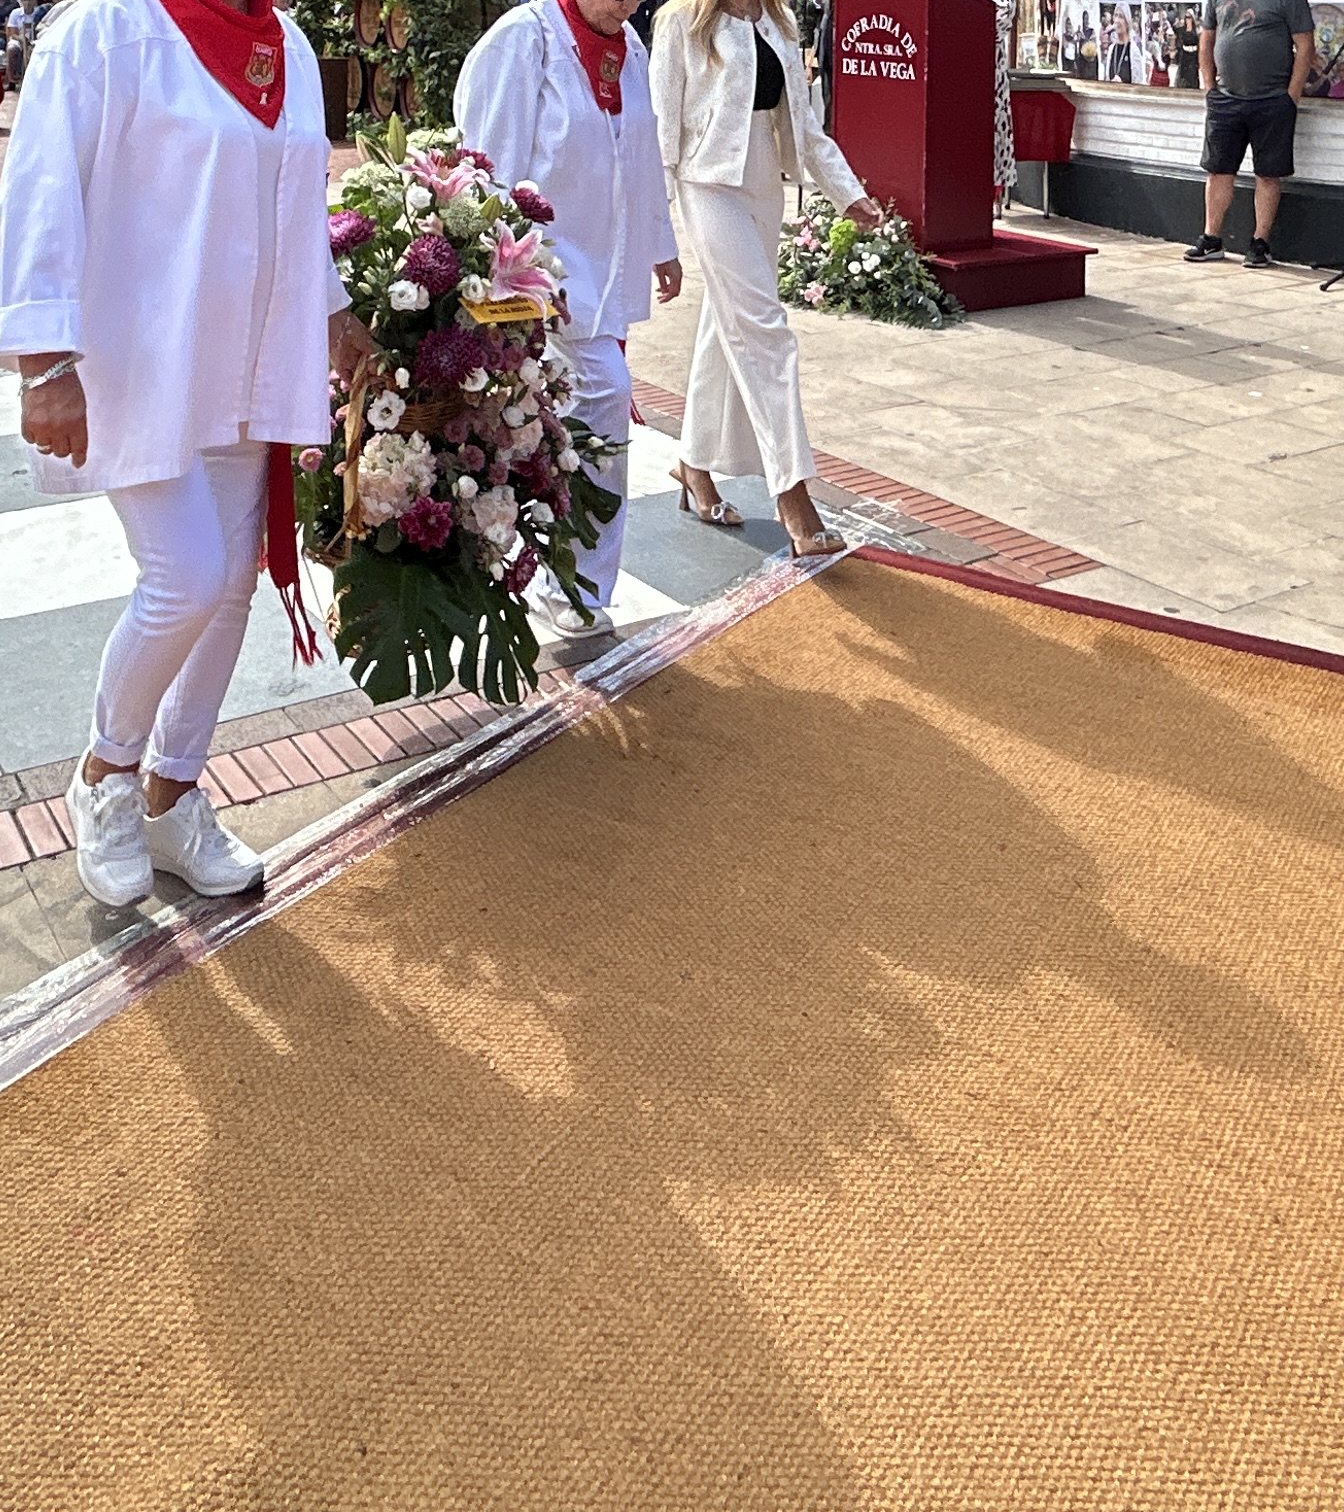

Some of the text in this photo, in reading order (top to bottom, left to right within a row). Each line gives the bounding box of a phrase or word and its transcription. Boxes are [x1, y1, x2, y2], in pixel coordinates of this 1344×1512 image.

[841, 14, 917, 58] COFRADIA DE
[855, 42, 882, 55] NTRA.
[842, 58, 915, 80] DE LA VEGA
